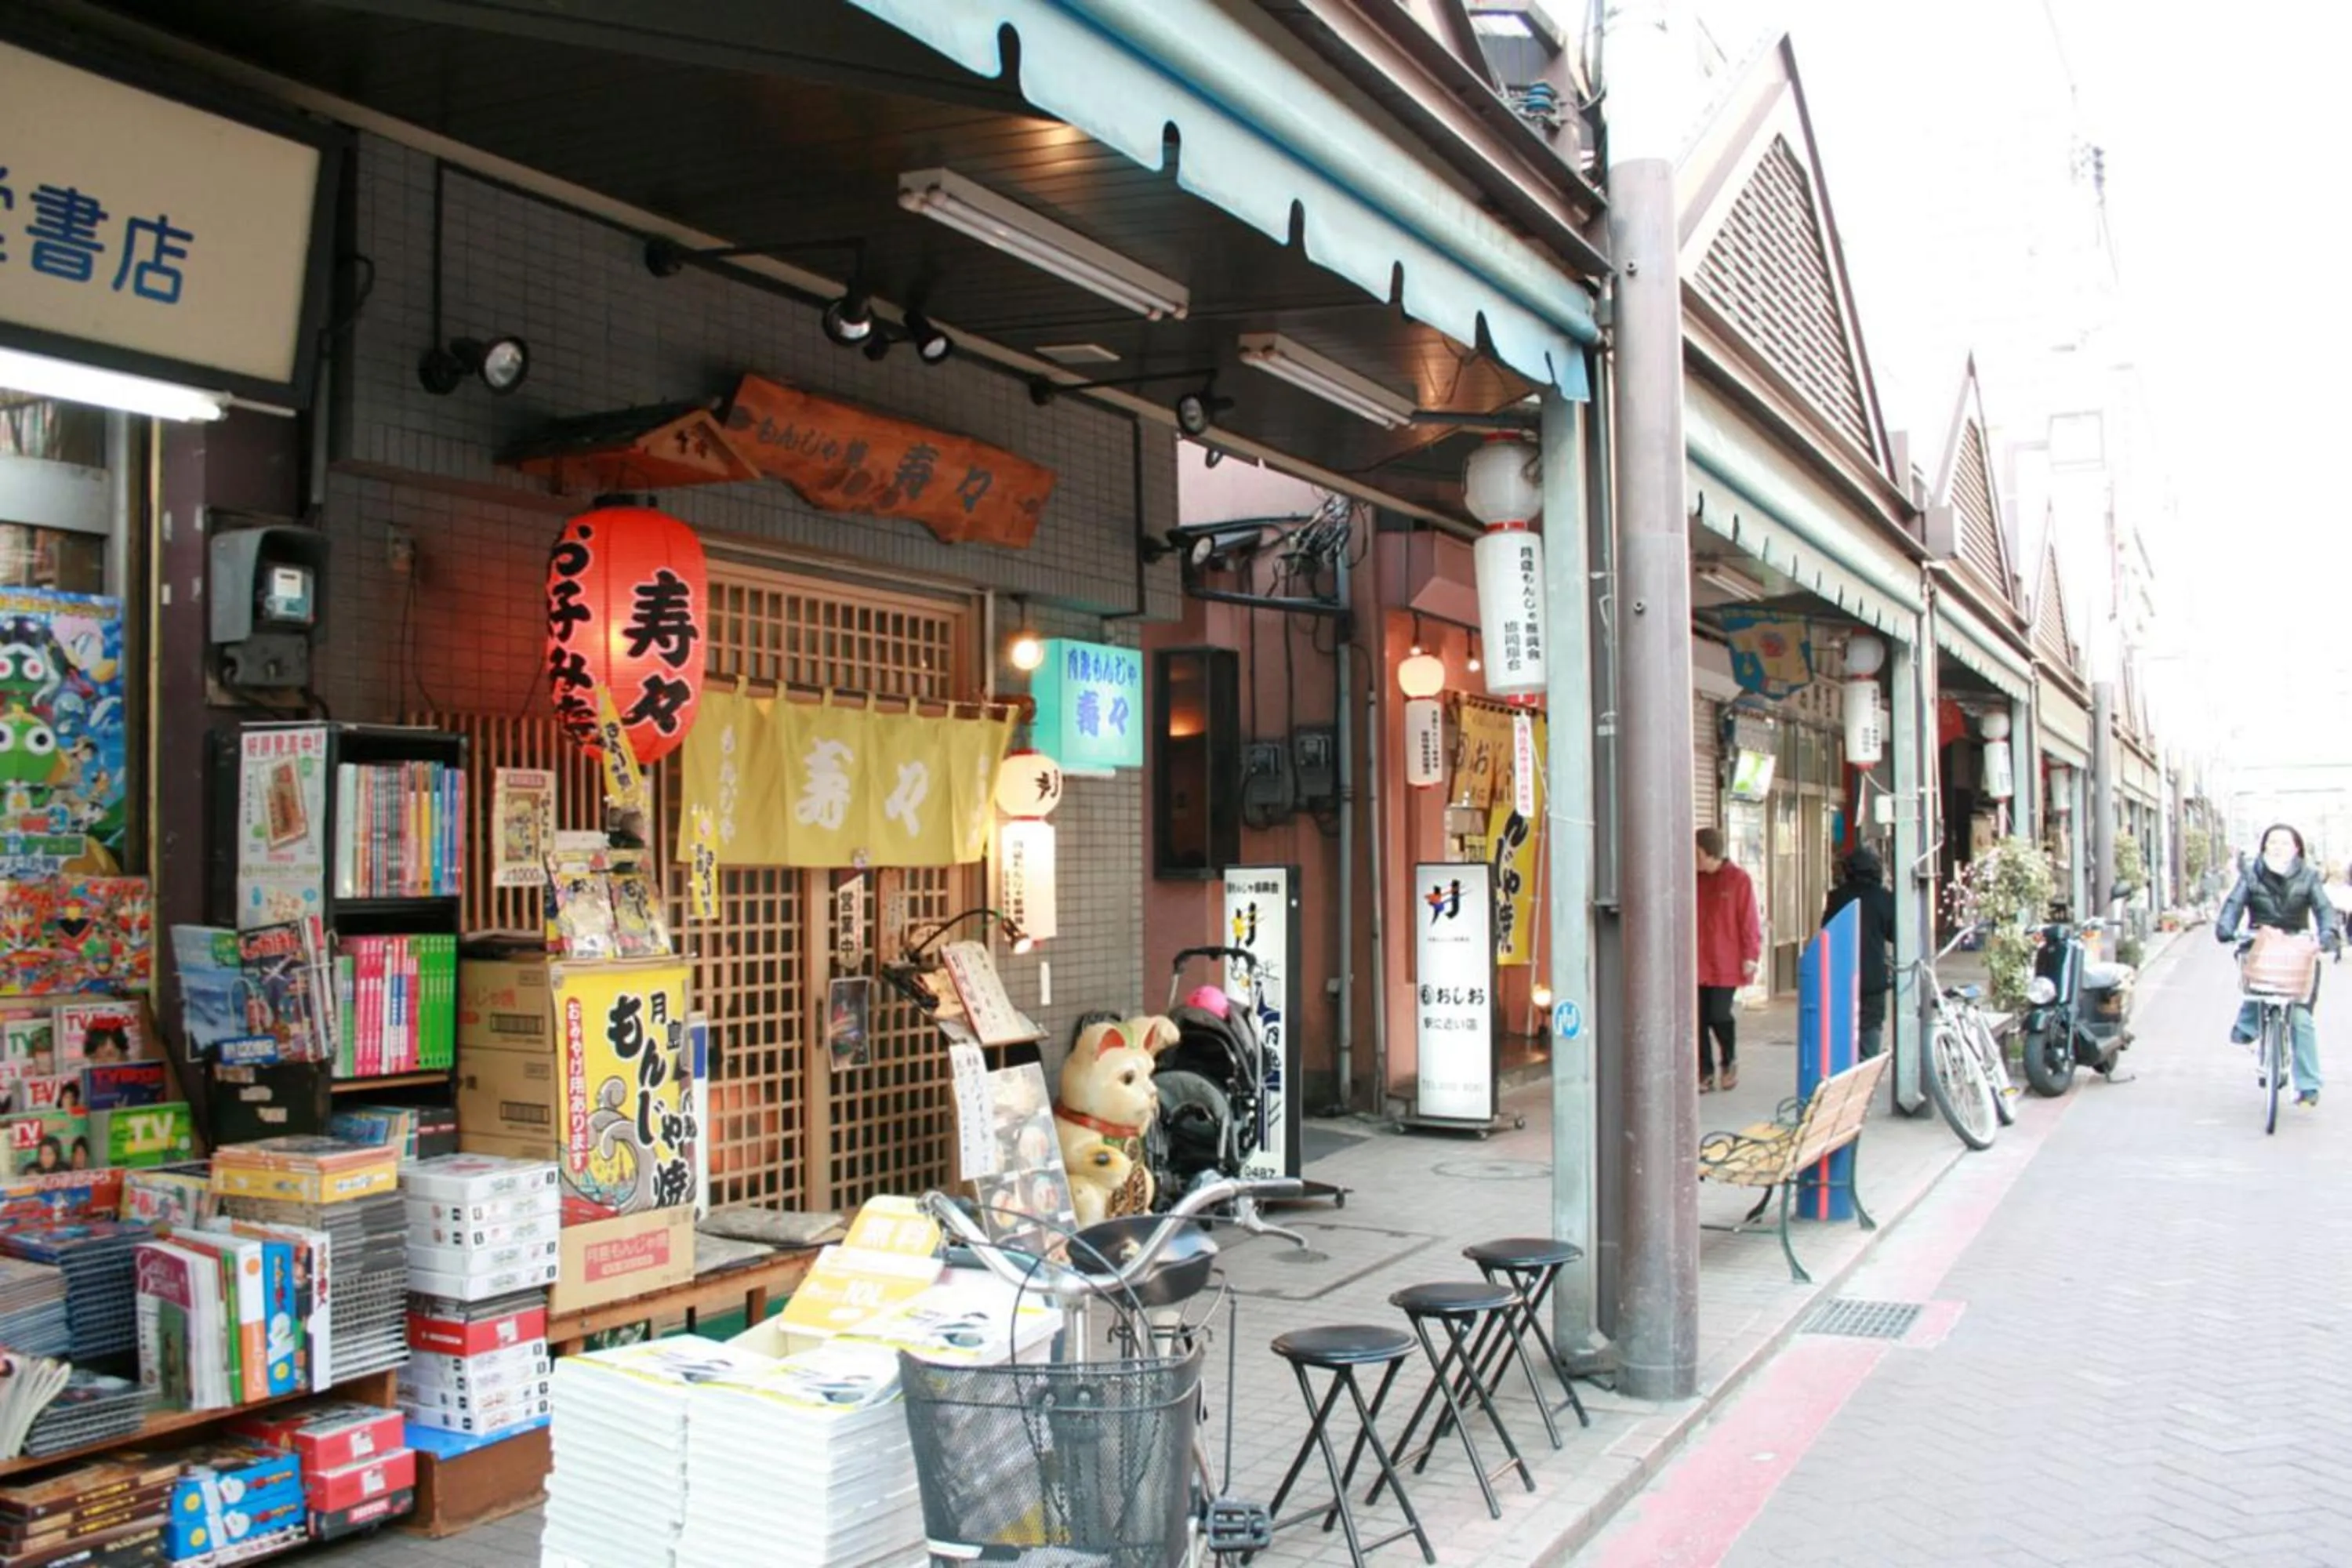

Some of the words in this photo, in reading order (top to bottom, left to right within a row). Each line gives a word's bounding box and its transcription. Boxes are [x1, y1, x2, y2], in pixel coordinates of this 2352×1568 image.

[624, 569, 699, 735] 寿々
[128, 1112, 174, 1143] TV
[567, 1003, 586, 1168] おみやげ用あります
[608, 995, 689, 1210] もんじゃ焼
